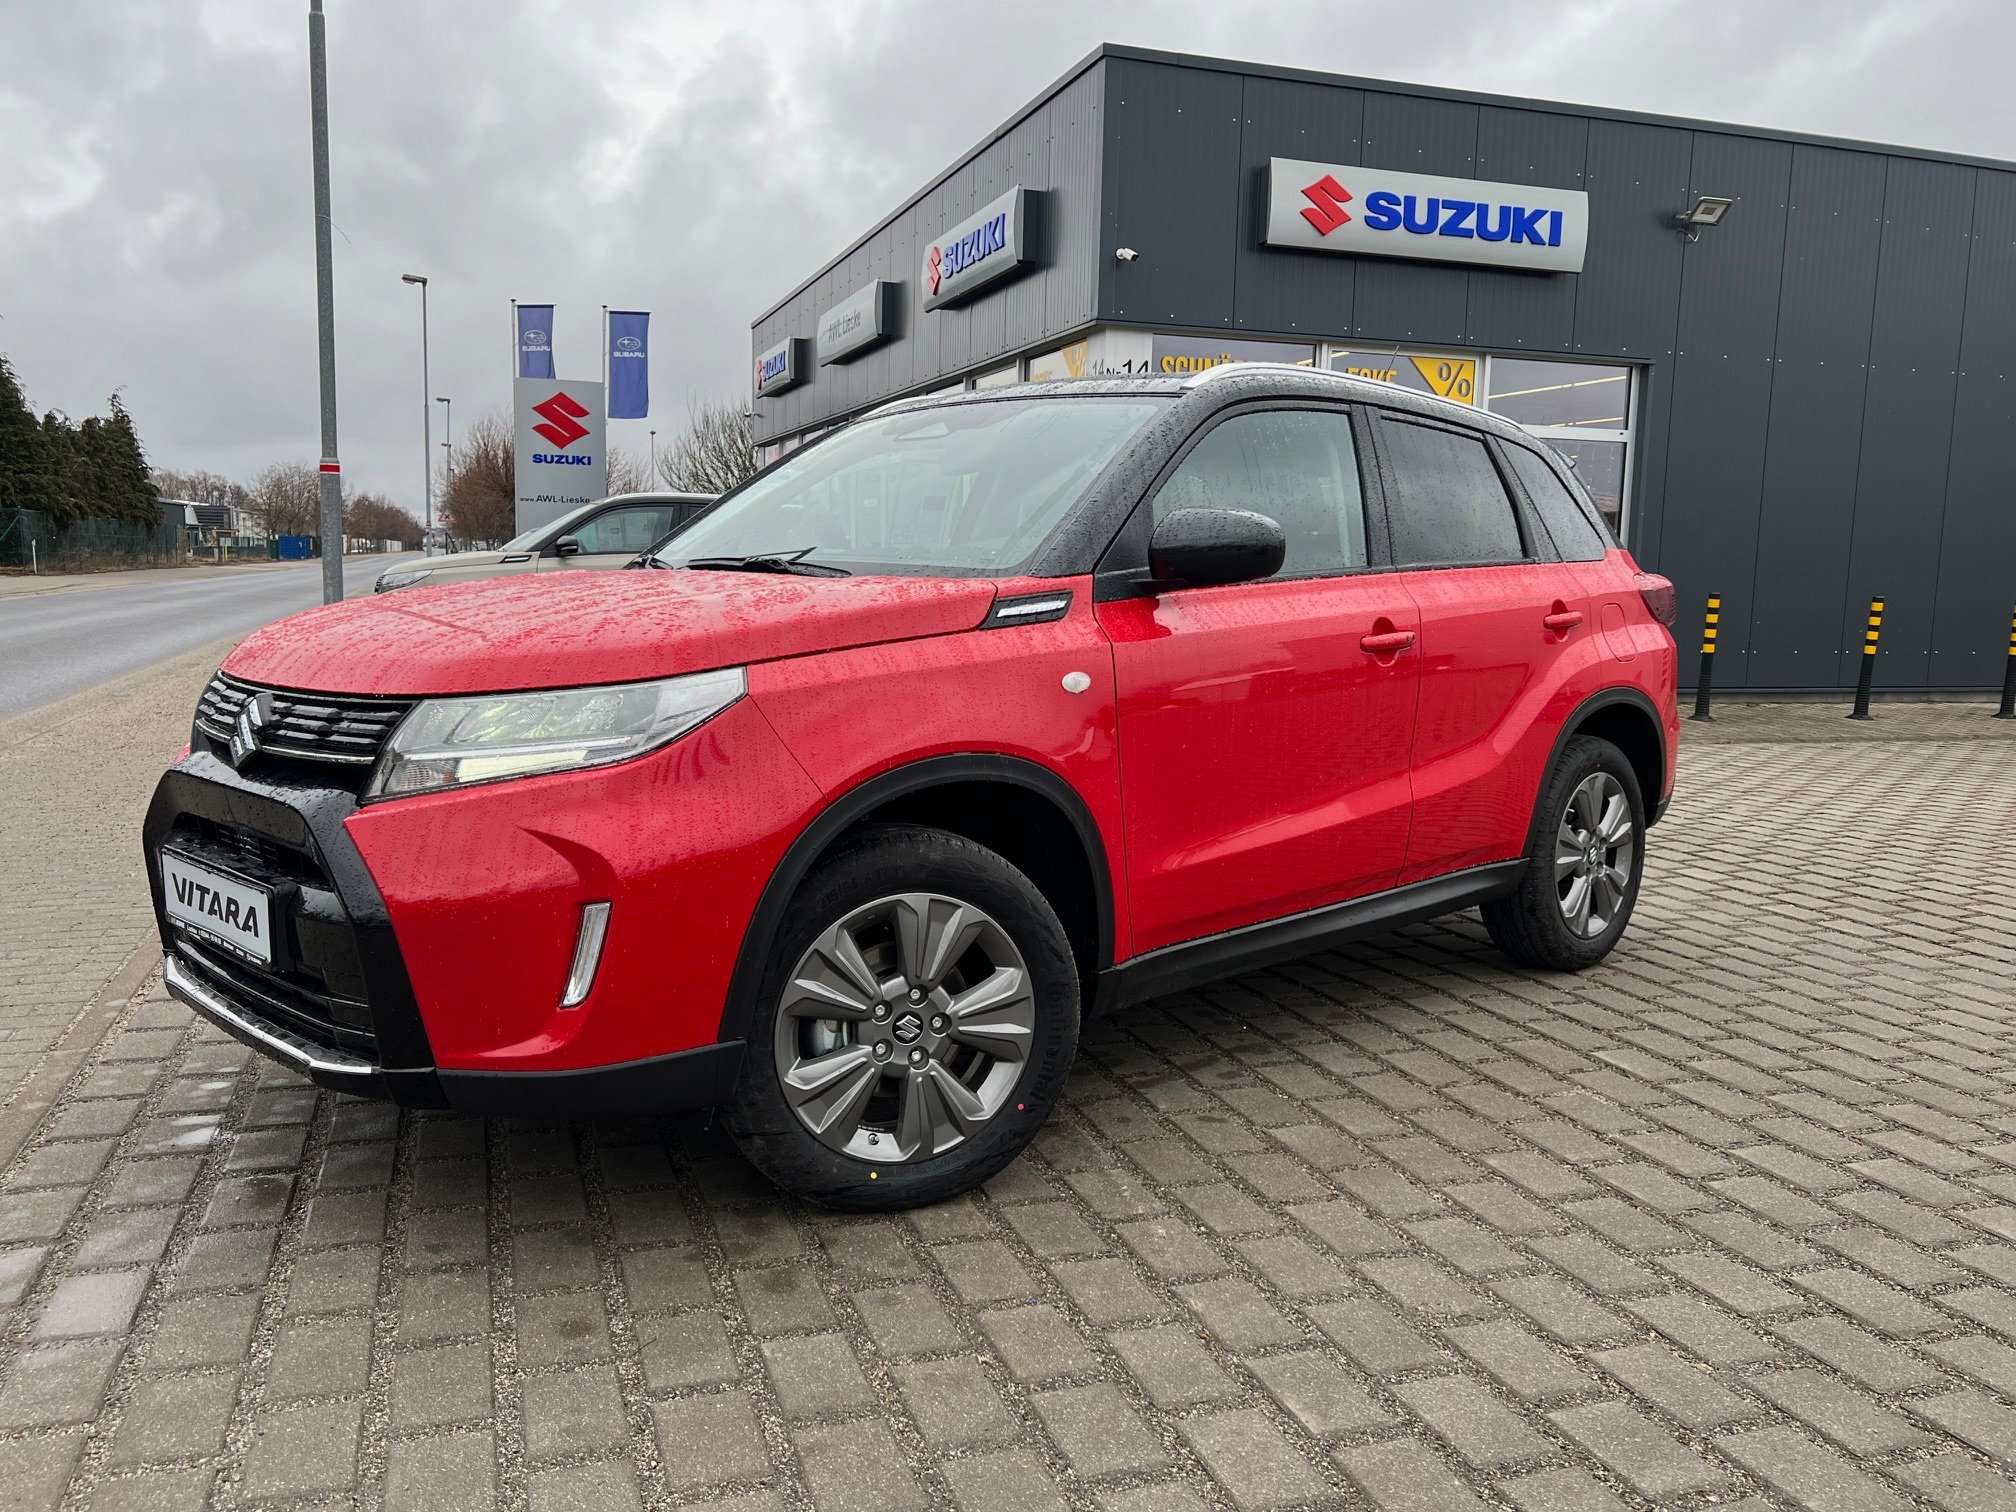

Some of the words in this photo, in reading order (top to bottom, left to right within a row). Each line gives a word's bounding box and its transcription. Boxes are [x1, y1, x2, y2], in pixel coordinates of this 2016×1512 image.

[943, 213, 1006, 280] SUZUKI
[1364, 191, 1563, 247] SUZUKI
[532, 453, 592, 466] SUZUKI
[171, 872, 259, 939] VITARA
